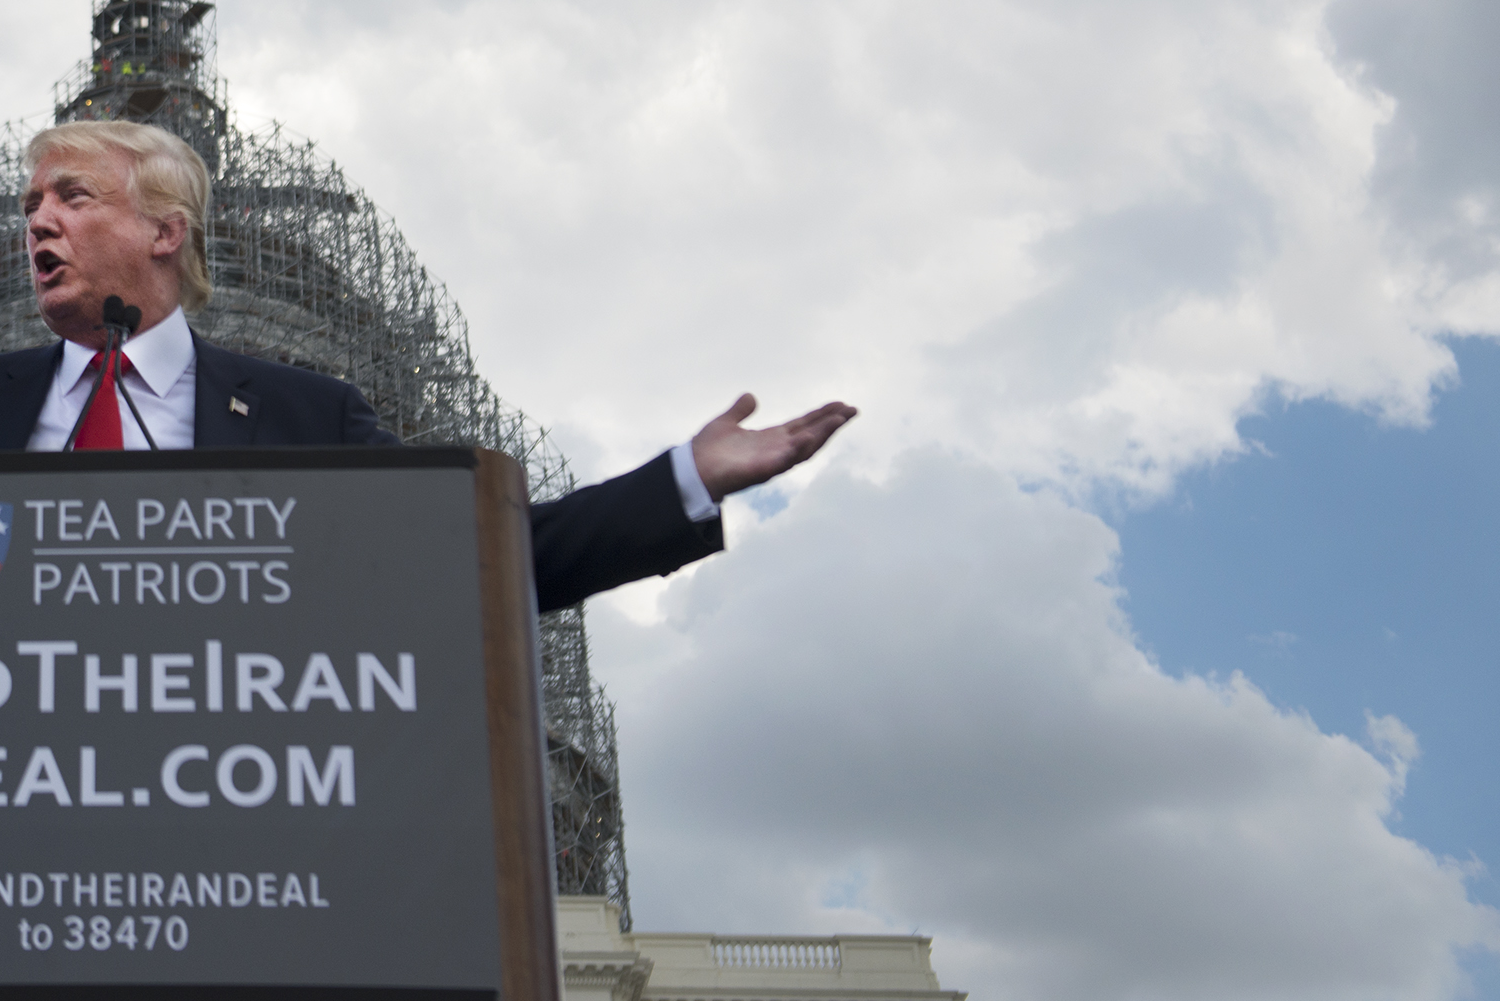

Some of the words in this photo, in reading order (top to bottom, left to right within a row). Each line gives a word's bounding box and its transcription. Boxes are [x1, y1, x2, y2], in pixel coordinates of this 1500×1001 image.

[25, 500, 120, 540] TEA
[138, 498, 296, 539] PARTY
[34, 561, 290, 604] PATRIOTS
[19, 919, 53, 950] to
[64, 916, 188, 950] 38470
